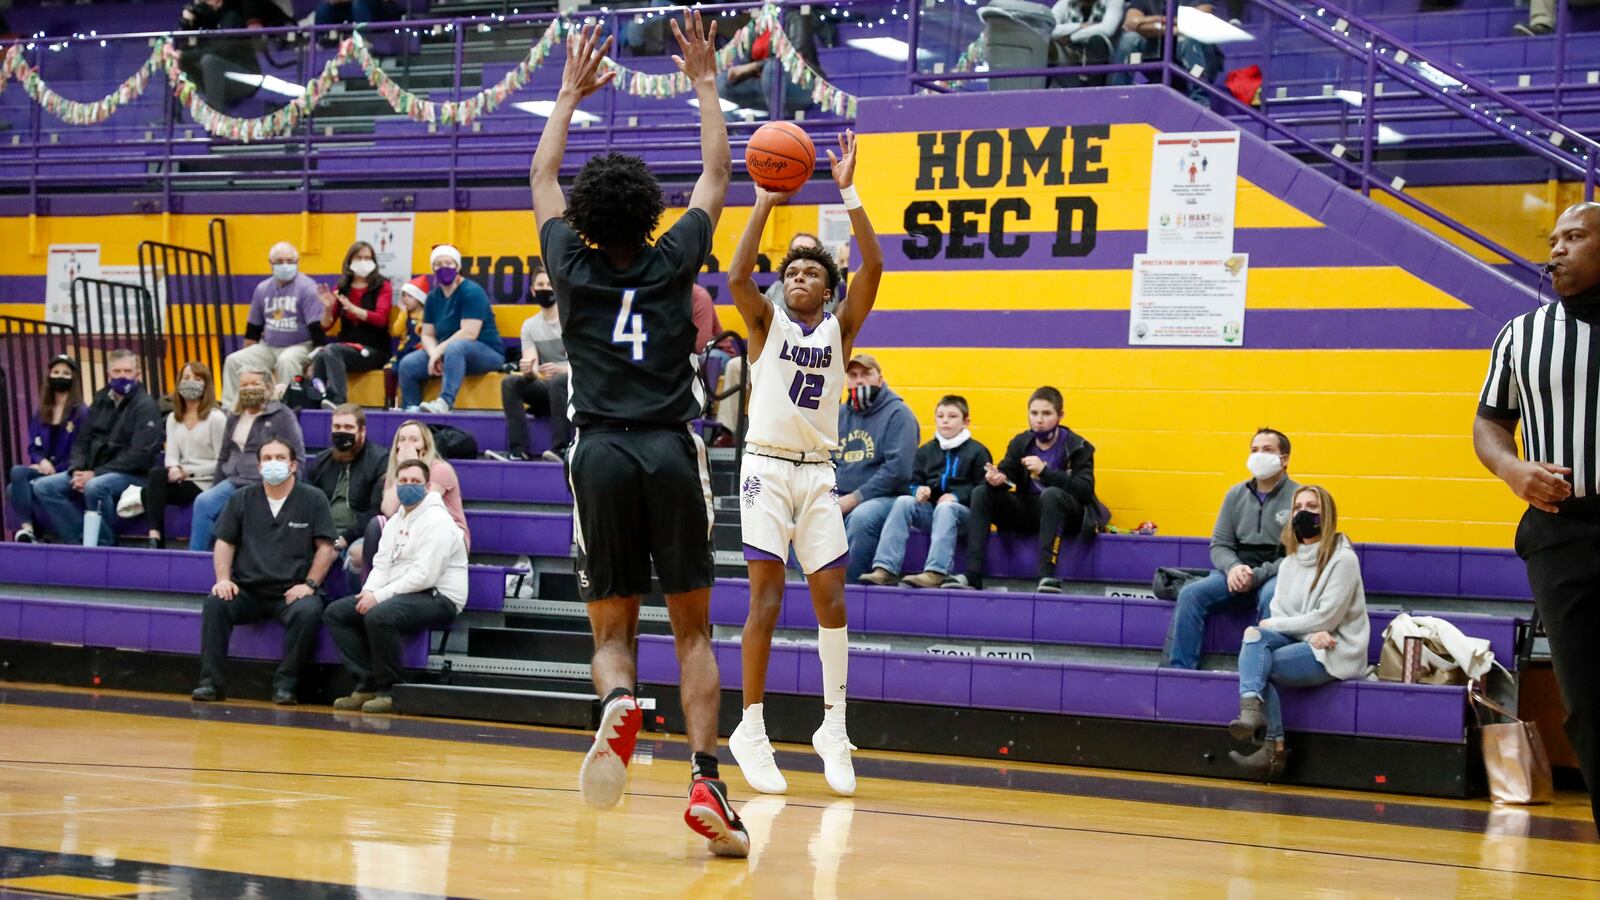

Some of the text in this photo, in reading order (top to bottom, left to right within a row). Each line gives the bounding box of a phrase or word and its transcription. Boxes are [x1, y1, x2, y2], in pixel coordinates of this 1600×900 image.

[749, 154, 788, 174] Rawlings
[915, 124, 1111, 190] HOME
[902, 196, 1098, 260] SEC D
[612, 289, 648, 361] 4
[779, 339, 832, 368] LIONS
[788, 369, 825, 410] 12
